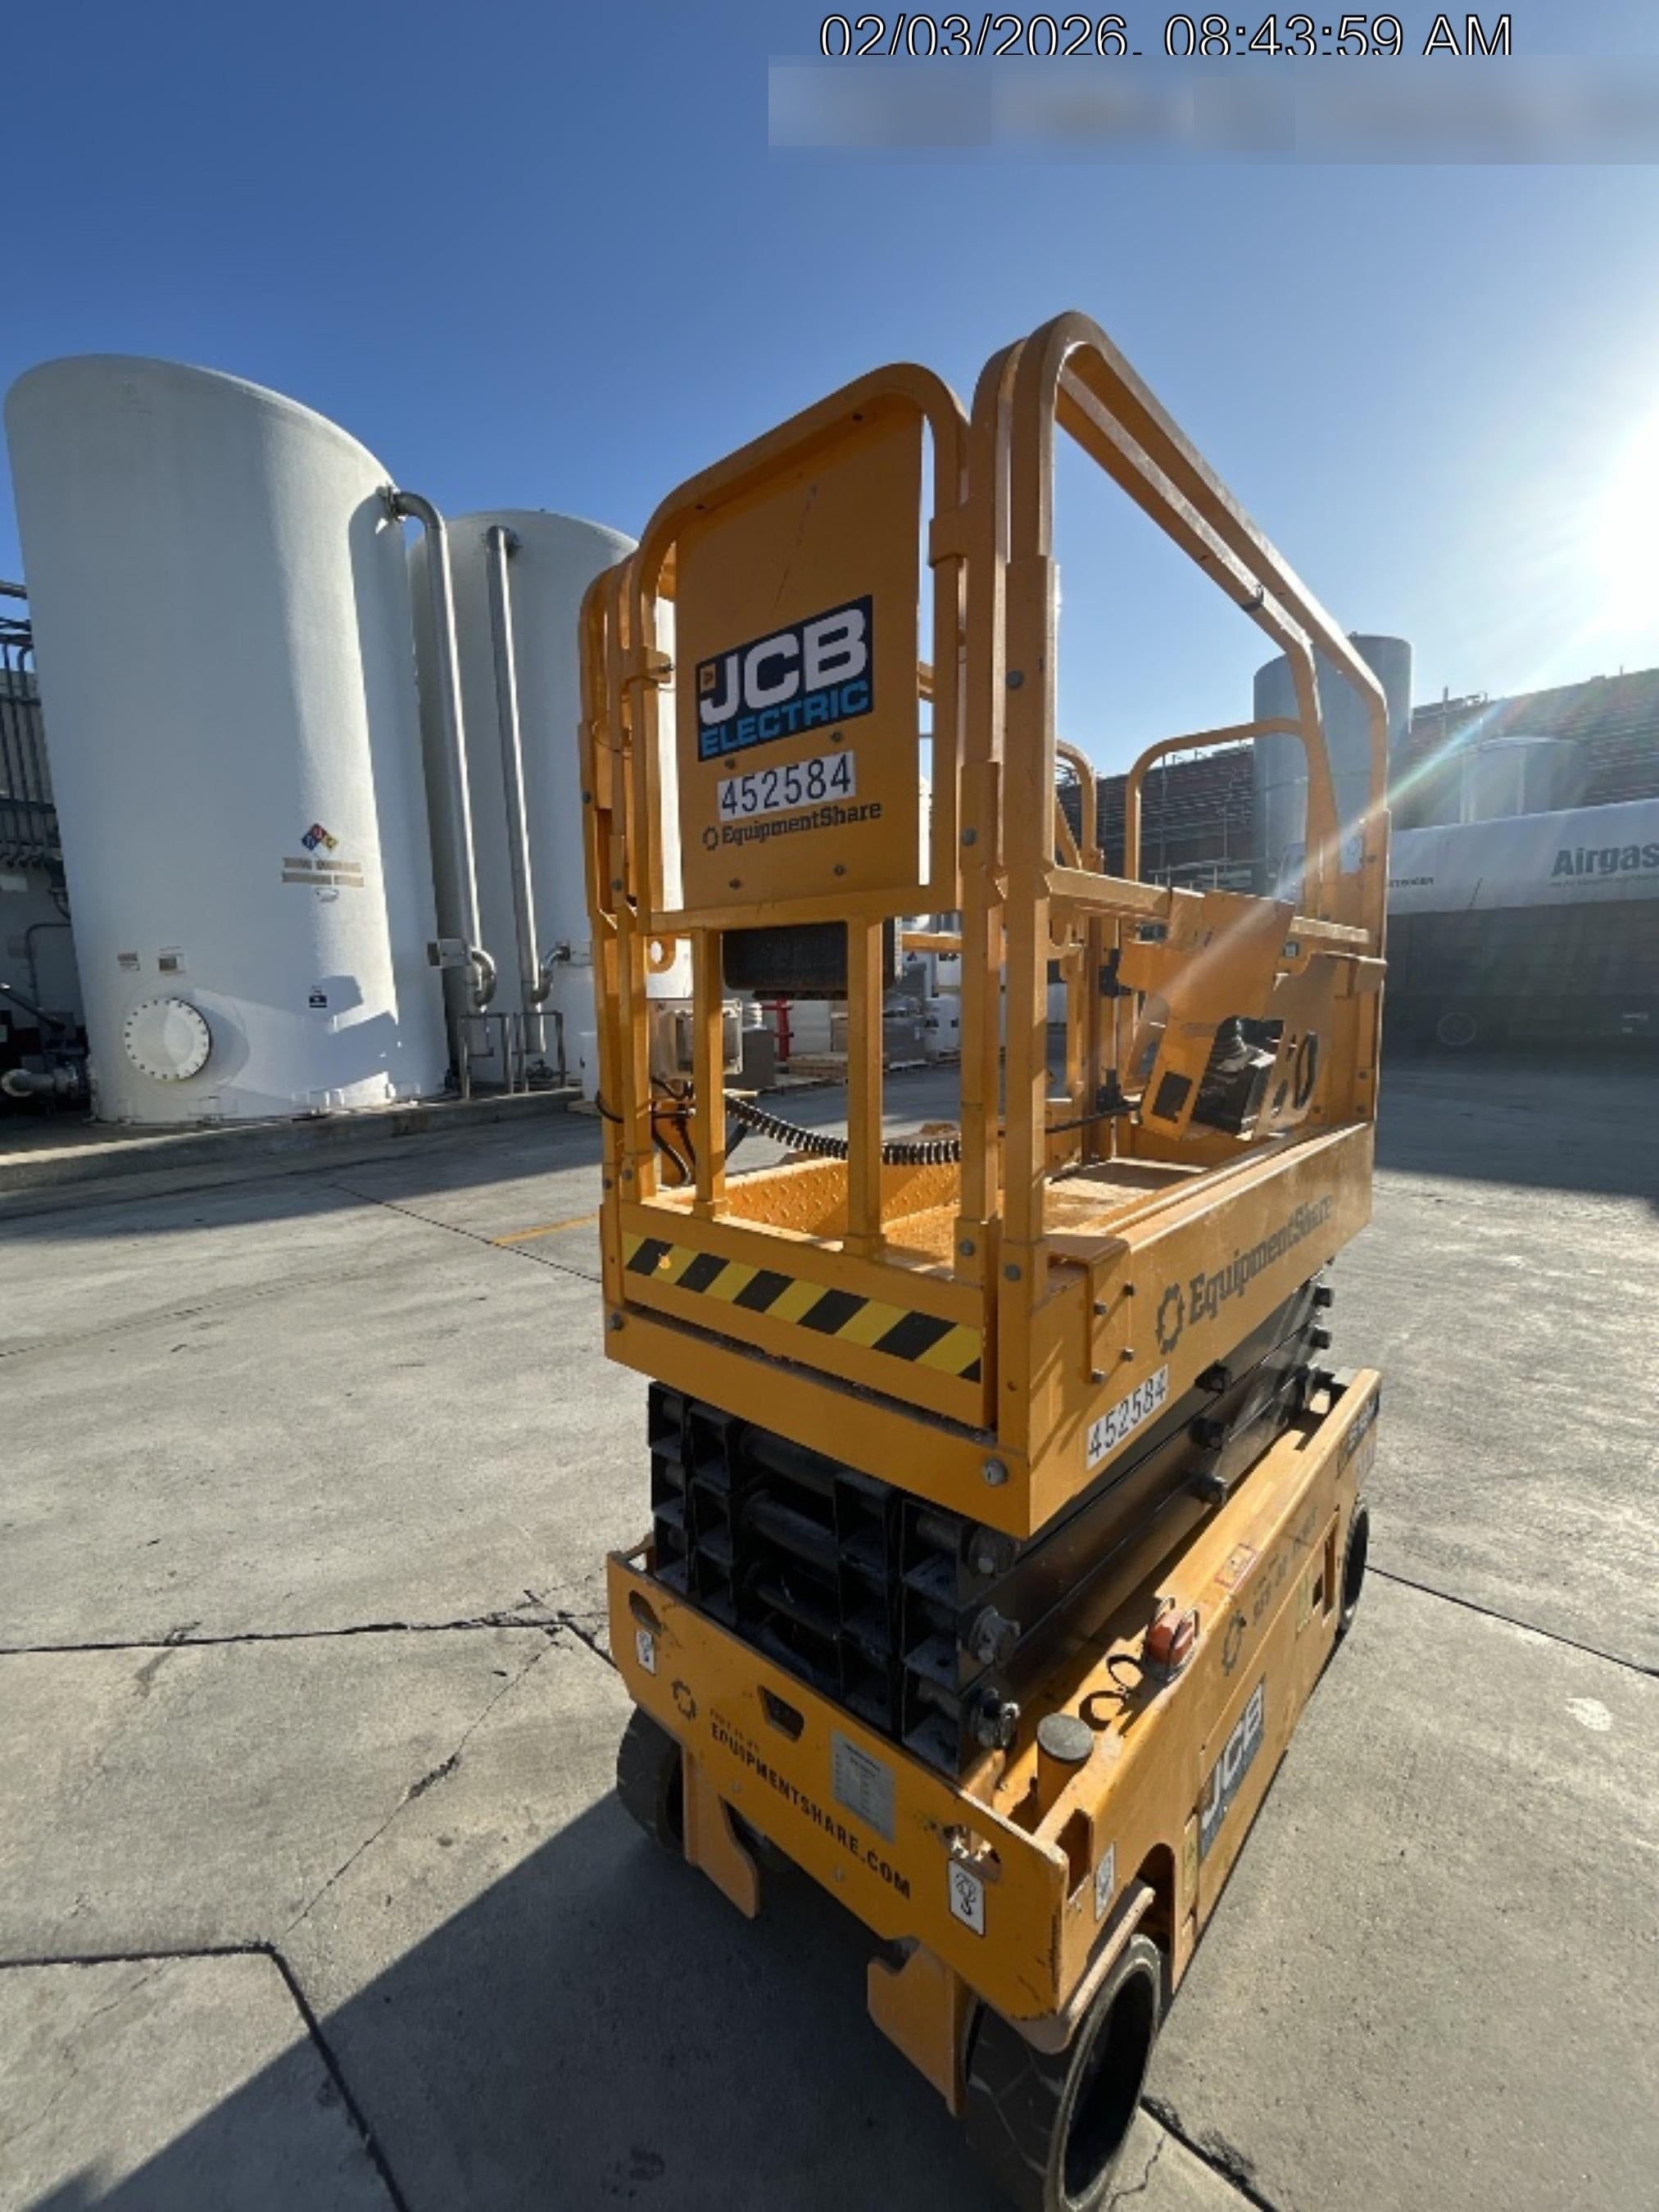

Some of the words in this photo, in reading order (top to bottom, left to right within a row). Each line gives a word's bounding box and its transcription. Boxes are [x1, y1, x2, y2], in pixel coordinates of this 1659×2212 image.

[700, 608, 868, 725] JCB
[702, 680, 868, 758] ELECTRIC
[721, 753, 851, 815] 452584
[722, 802, 882, 845] EquipmentShare
[1551, 842, 1659, 877] Airgas
[1188, 1195, 1332, 1326] EquipmentShare
[1088, 1368, 1167, 1460] 452584
[1201, 1683, 1263, 1830] JCB
[711, 1722, 911, 1901] EQUIPMENTSHARE.COM
